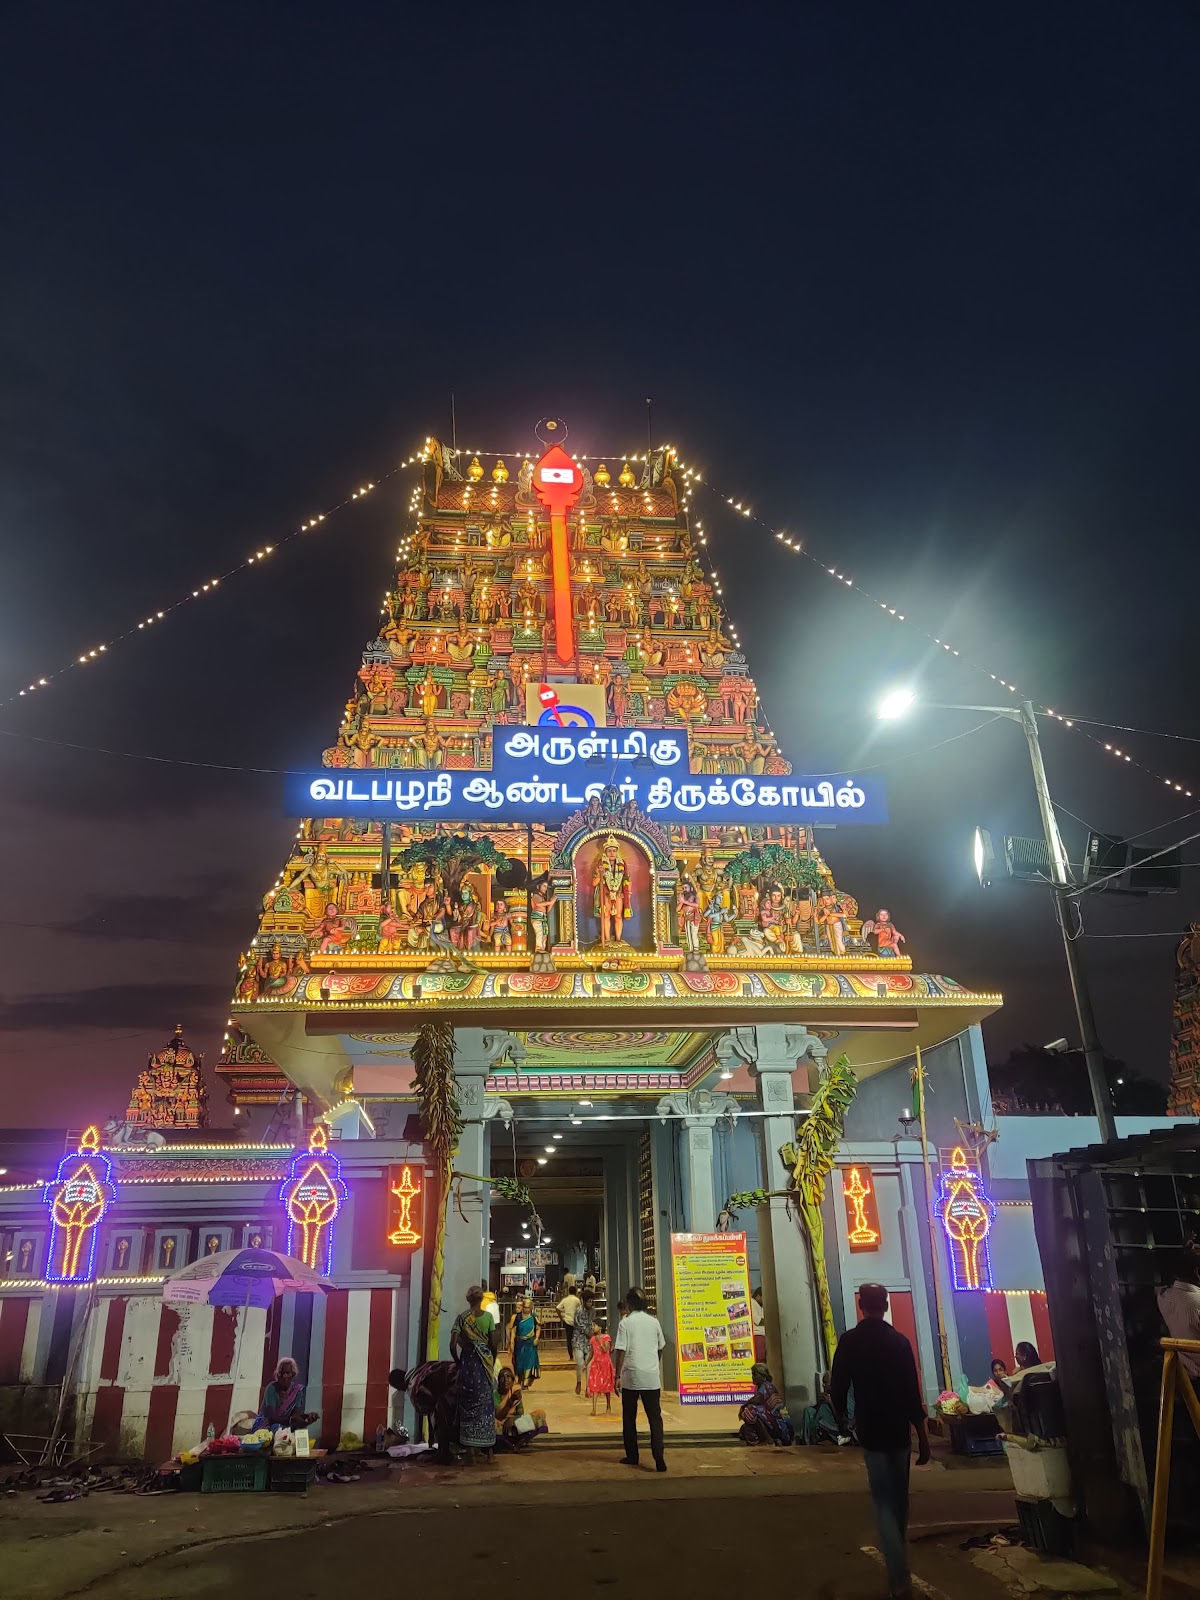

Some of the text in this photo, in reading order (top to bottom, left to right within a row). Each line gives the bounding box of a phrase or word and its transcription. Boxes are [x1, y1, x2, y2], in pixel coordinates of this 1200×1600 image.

[504, 730, 682, 766] அருள்மிகு
[309, 774, 452, 811] வடபழநி
[646, 776, 867, 813] திருக்கோயில்
